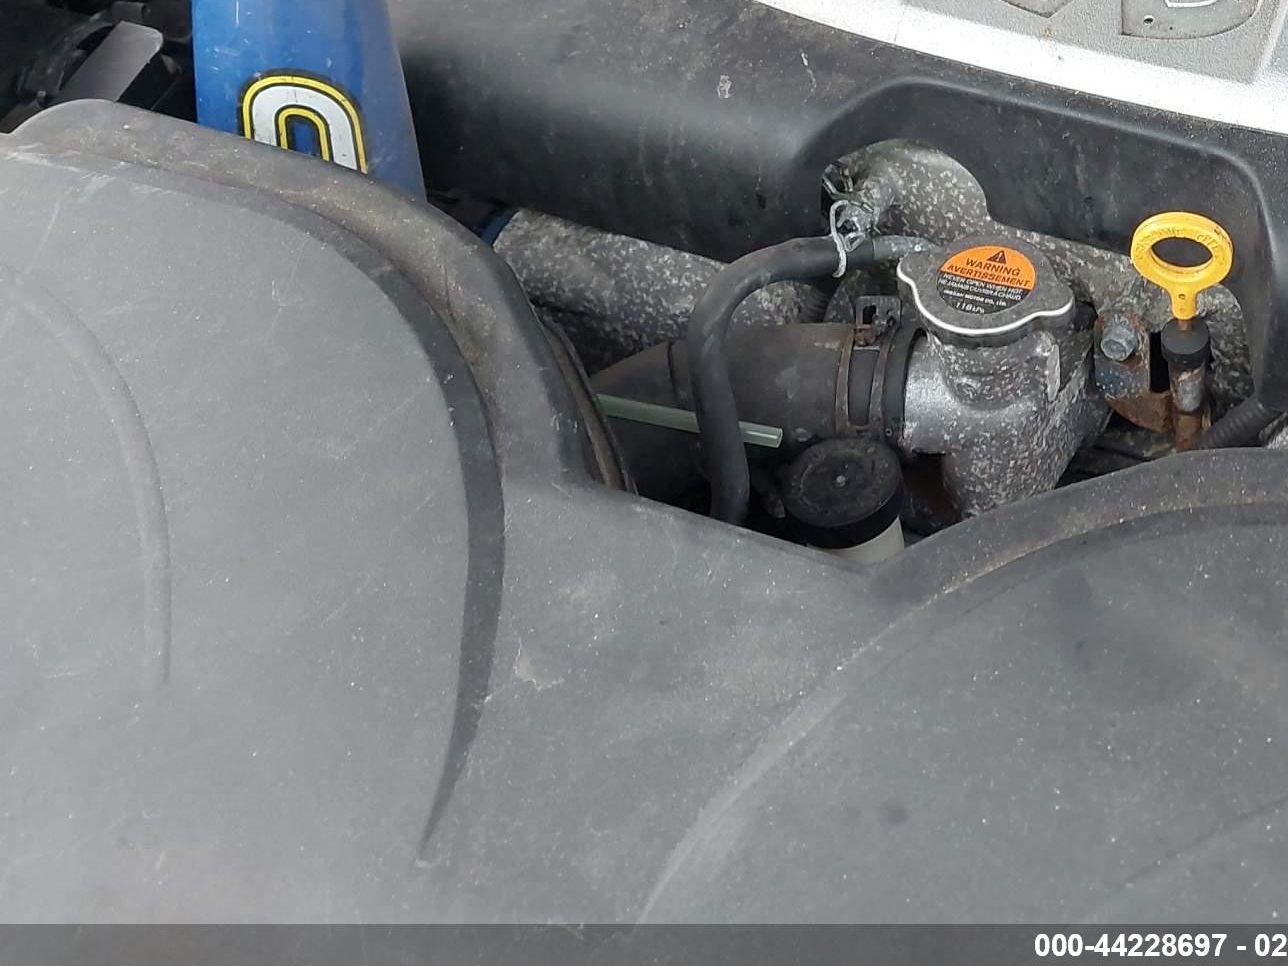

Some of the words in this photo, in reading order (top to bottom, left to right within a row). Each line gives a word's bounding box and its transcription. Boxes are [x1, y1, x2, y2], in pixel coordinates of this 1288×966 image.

[946, 264, 1031, 287] AVERTISSEMENT
[966, 257, 1021, 277] WARNING
[966, 279, 986, 288] OPEN
[986, 282, 1007, 292] WHEN
